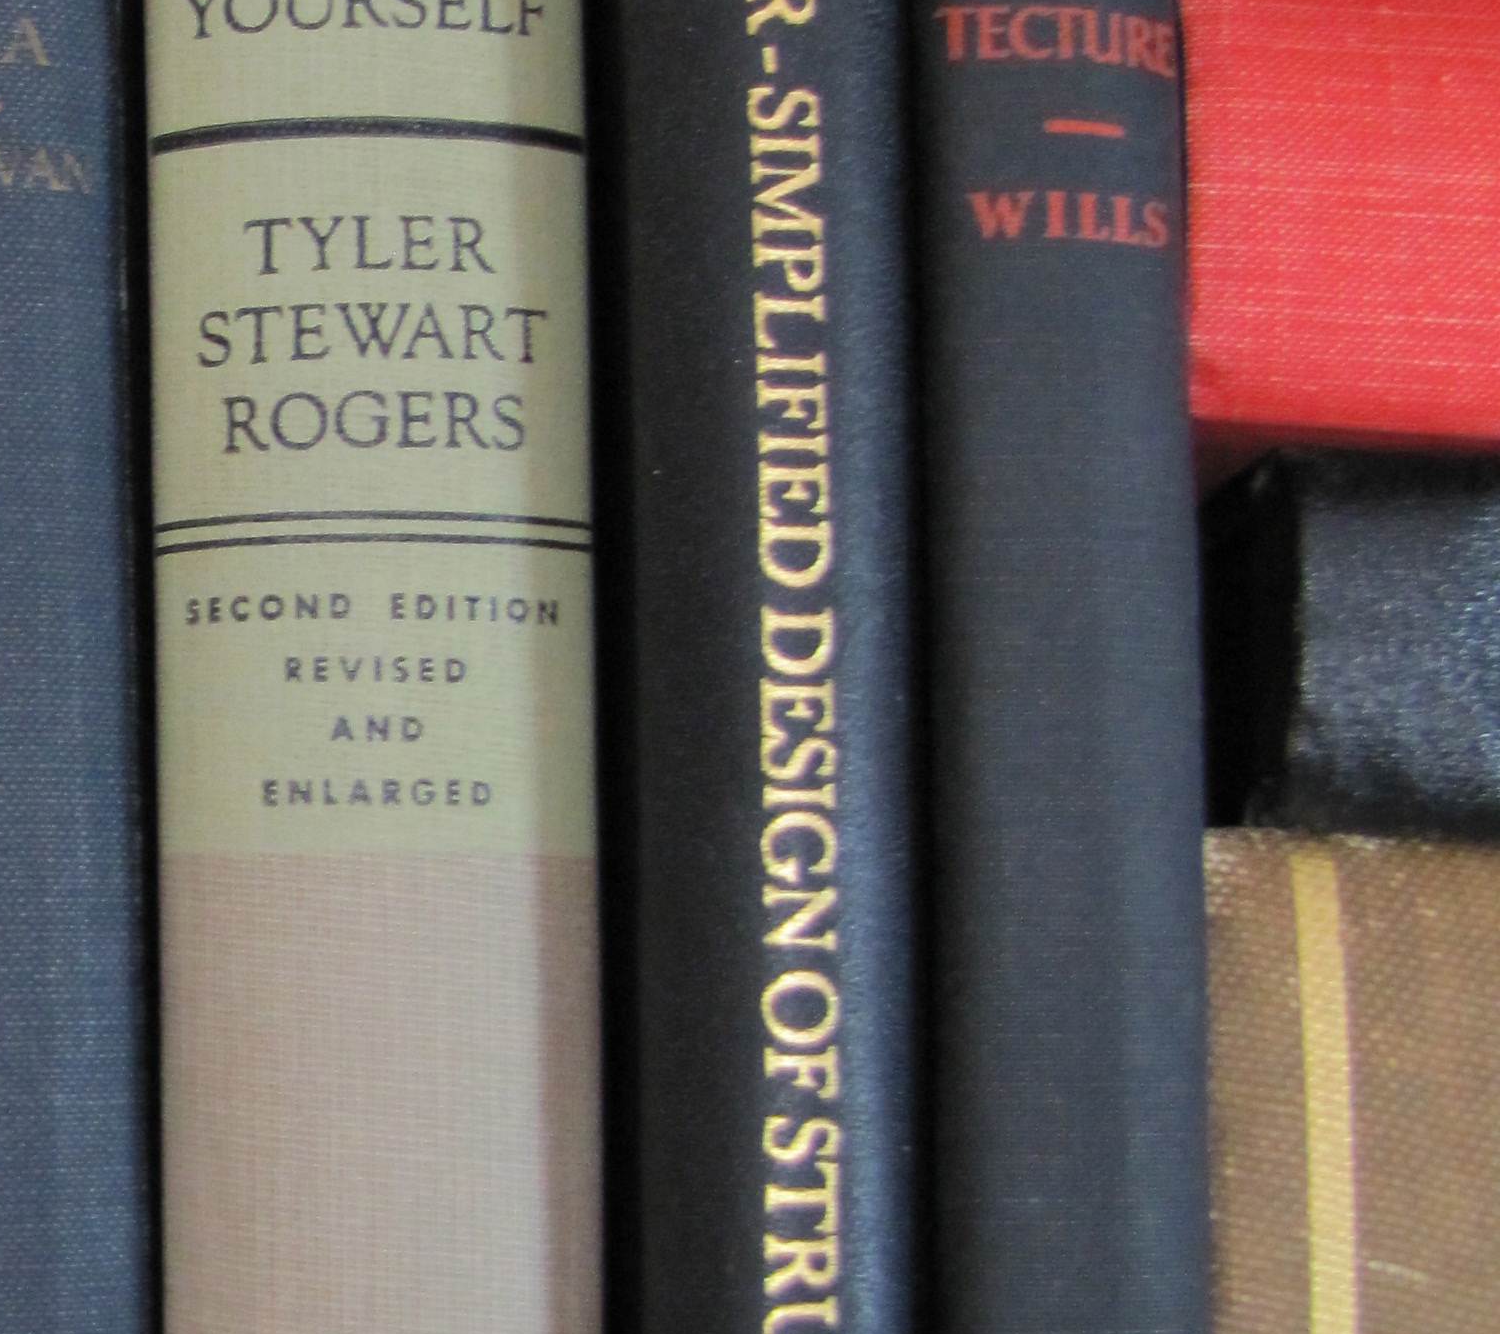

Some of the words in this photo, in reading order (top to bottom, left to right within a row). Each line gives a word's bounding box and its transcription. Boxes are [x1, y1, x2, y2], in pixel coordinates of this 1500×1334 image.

[932, 4, 1176, 78] TECTURE
[244, 215, 497, 275] TYLER
[968, 190, 1169, 249] WILLS
[197, 302, 549, 367] STEWART
[222, 391, 526, 454] ROGERS
[185, 593, 352, 625] SECOND
[390, 592, 560, 625] EDITION
[284, 656, 467, 684] REVISED
[330, 715, 425, 742] AND
[261, 779, 493, 807] ENLARGED
[759, 607, 840, 952] DESIGN
[760, 971, 842, 1101] OF
